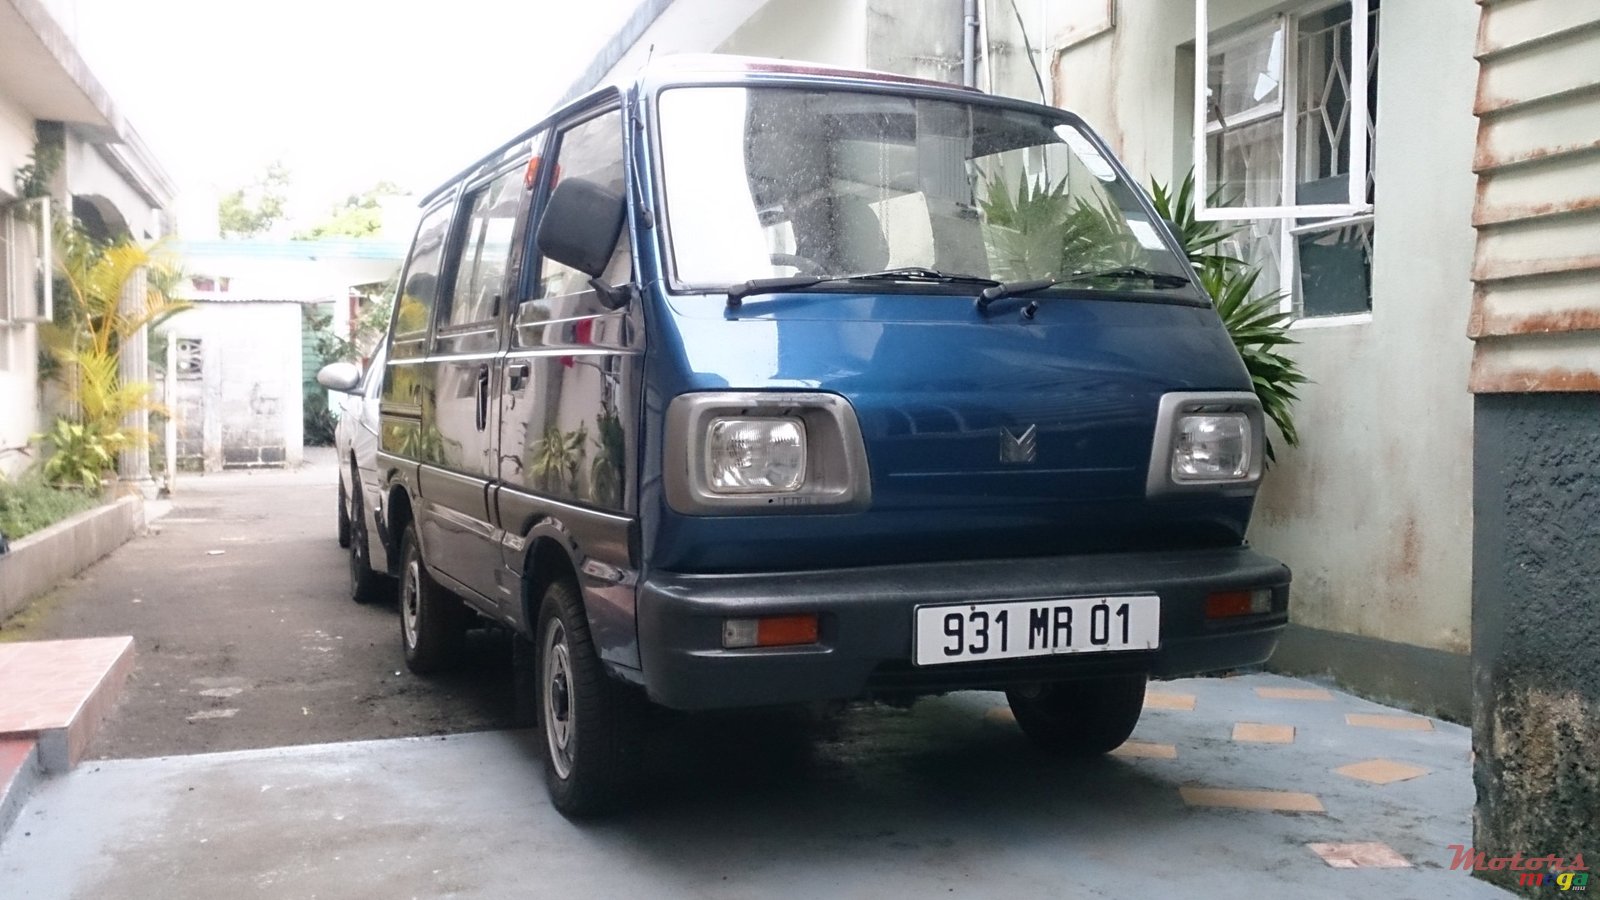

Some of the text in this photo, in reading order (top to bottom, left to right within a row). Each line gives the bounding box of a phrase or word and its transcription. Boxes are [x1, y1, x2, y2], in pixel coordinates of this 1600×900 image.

[943, 603, 1130, 656] 931 MR 01
